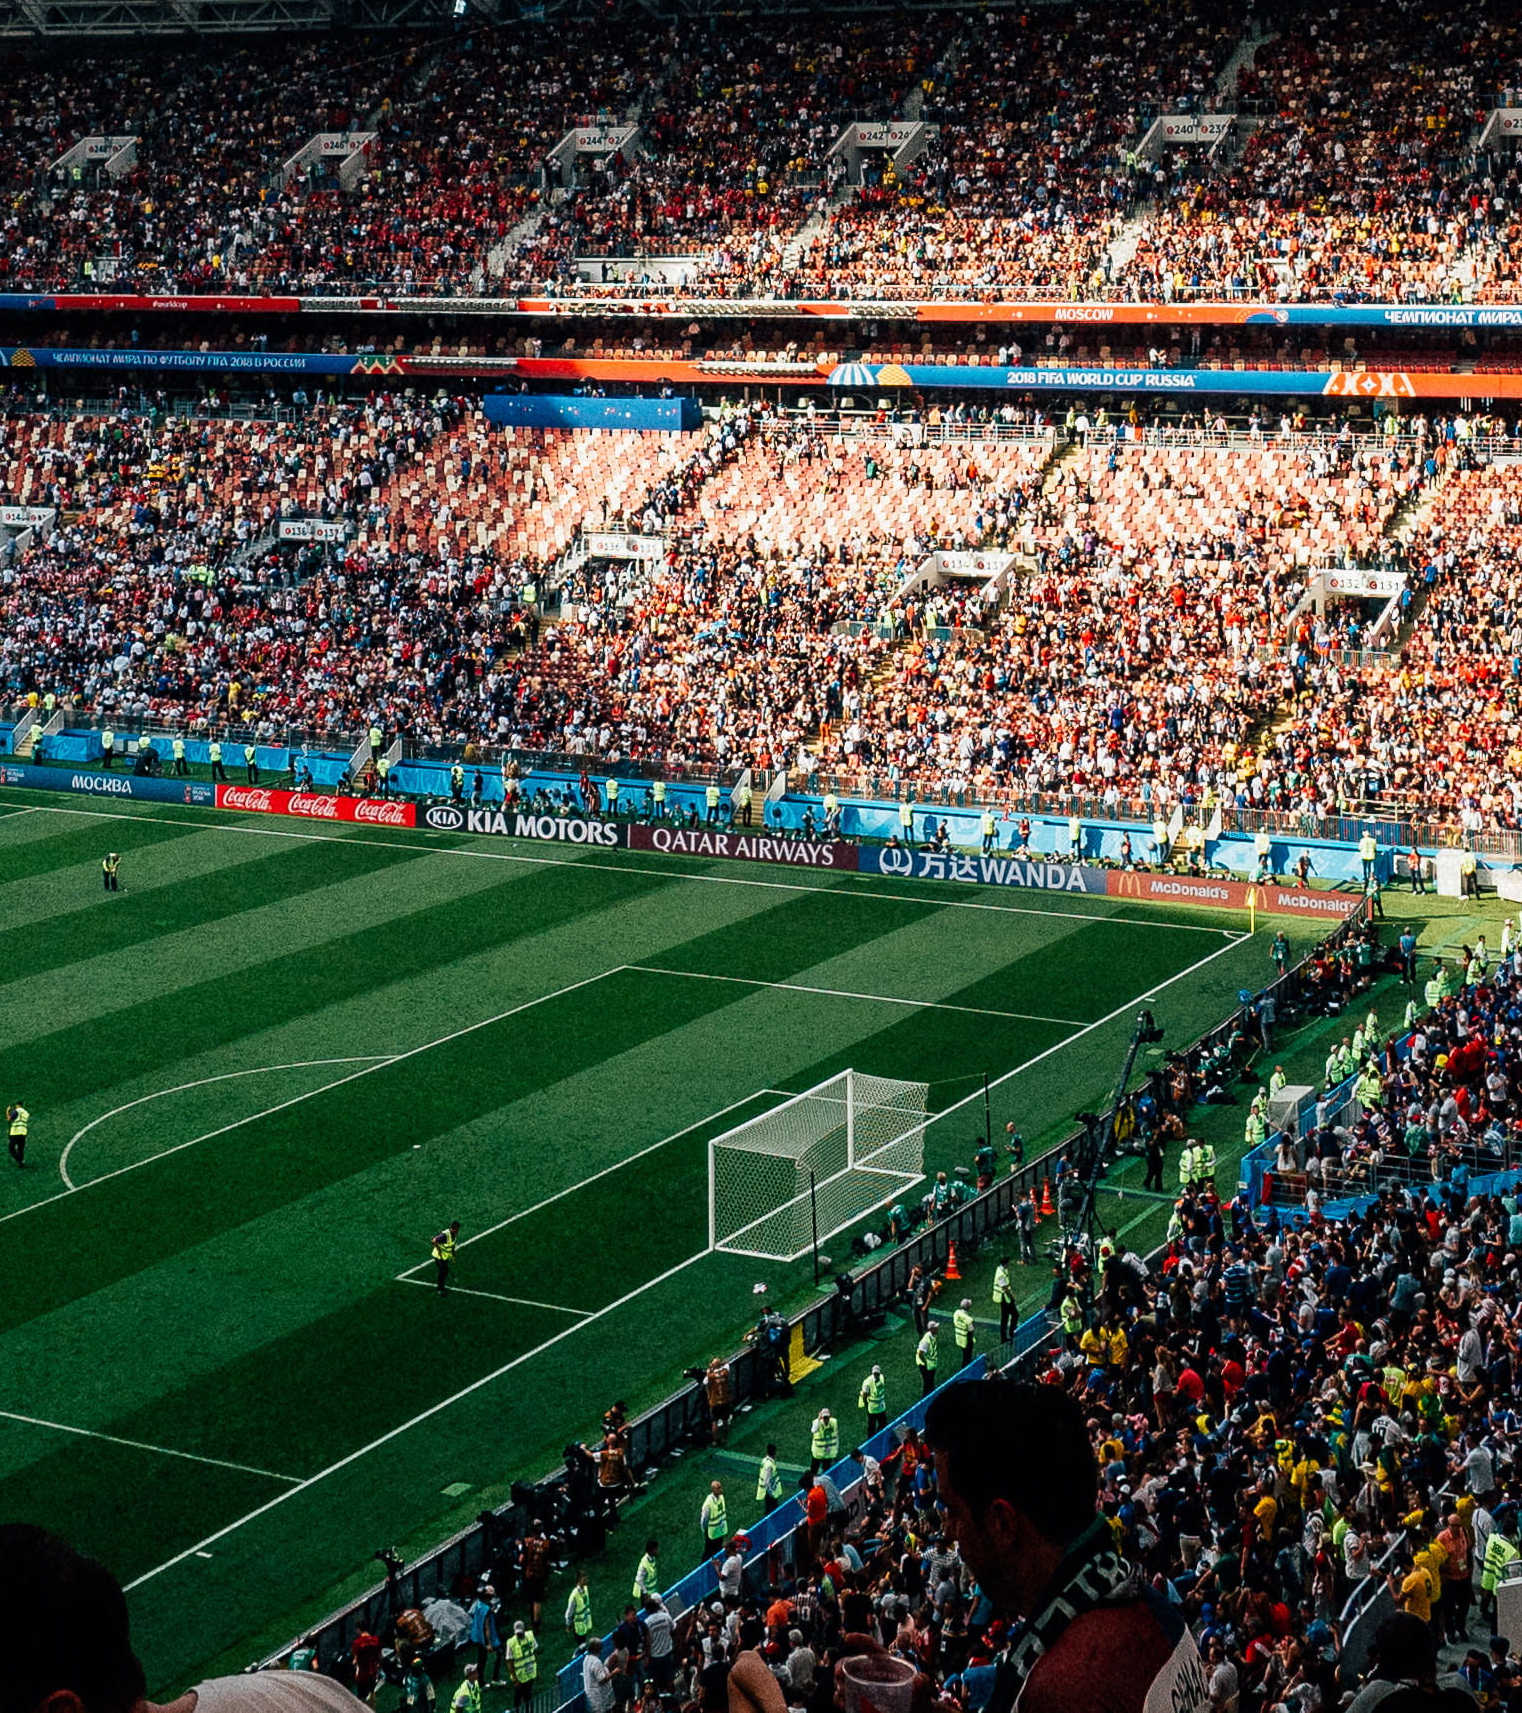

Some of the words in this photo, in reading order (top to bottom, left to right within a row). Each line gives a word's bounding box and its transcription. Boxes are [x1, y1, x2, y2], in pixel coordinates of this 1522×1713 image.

[867, 131, 883, 140] 242
[1175, 125, 1193, 135] 240
[1055, 308, 1114, 320] MOSCOW
[1385, 310, 1475, 324] ЧЕМПИОНАТ
[1478, 311, 1522, 325] МИРА
[112, 354, 141, 365] МИРА
[143, 354, 158, 365] ПО
[159, 355, 205, 367] ФУТБОЛУ
[230, 356, 253, 368] 2018
[263, 357, 305, 369] РОССИИ
[1007, 372, 1036, 384] 2018
[1038, 372, 1065, 385] FIFA
[1066, 373, 1113, 386] WORLD
[1115, 373, 1143, 386] CUP
[1146, 374, 1195, 388] RUSSIA
[1380, 581, 1399, 591] 131
[71, 774, 133, 795] МОСКВА
[431, 810, 458, 825] KIA
[467, 809, 509, 836] KIA
[514, 814, 619, 847] MOTORS
[652, 828, 729, 855] QATAR
[735, 836, 834, 866] AIRWAYS
[918, 852, 978, 884] 万达
[979, 859, 1088, 894] WANDA
[1150, 879, 1229, 901] McDonald's
[1277, 892, 1357, 914] McDonald's
